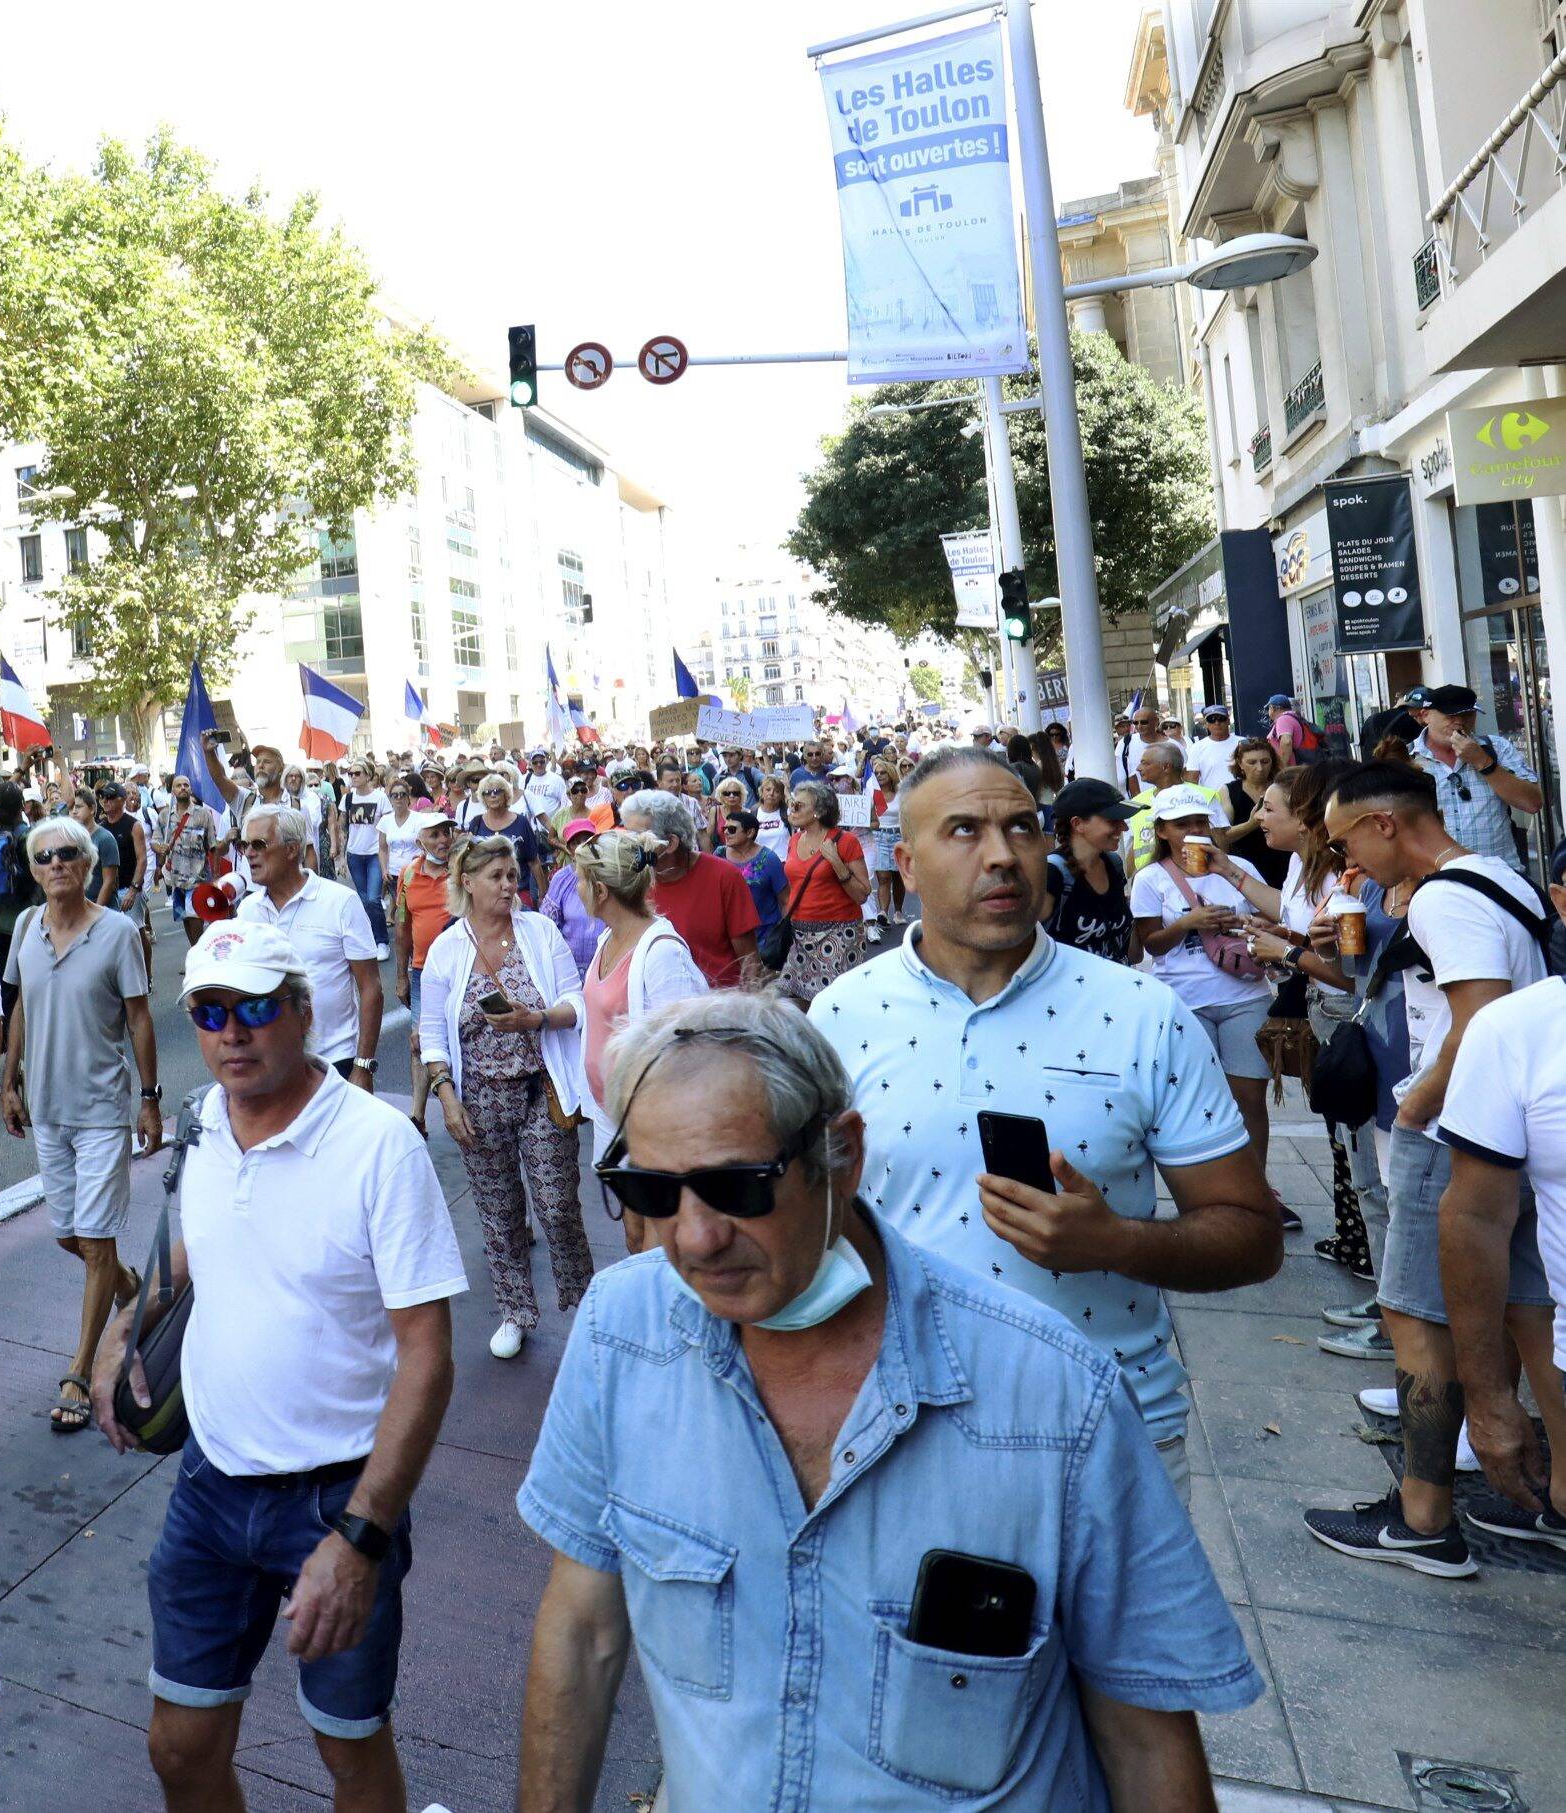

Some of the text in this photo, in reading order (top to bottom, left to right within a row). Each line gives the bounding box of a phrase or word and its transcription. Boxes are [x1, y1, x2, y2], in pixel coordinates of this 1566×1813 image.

[836, 59, 994, 115] Les Halles
[848, 94, 991, 145] de Toulon
[845, 154, 887, 178] sont
[890, 137, 988, 172] ouvertes
[938, 216, 987, 230] TOULON
[1469, 455, 1563, 477] Carrefour
[1500, 473, 1537, 489] city
[1333, 494, 1368, 508] spok.
[1337, 539, 1360, 548] PLATS
[1374, 536, 1394, 544] JOUR
[1337, 547, 1371, 556] SALADES
[1338, 554, 1382, 565] SANDWICHS
[1339, 564, 1369, 573] SOUPES
[1377, 560, 1405, 570] RAMEN
[1340, 571, 1379, 581] DESSERTS
[1037, 677, 1067, 700] BERT
[839, 796, 866, 809] TAIRE
